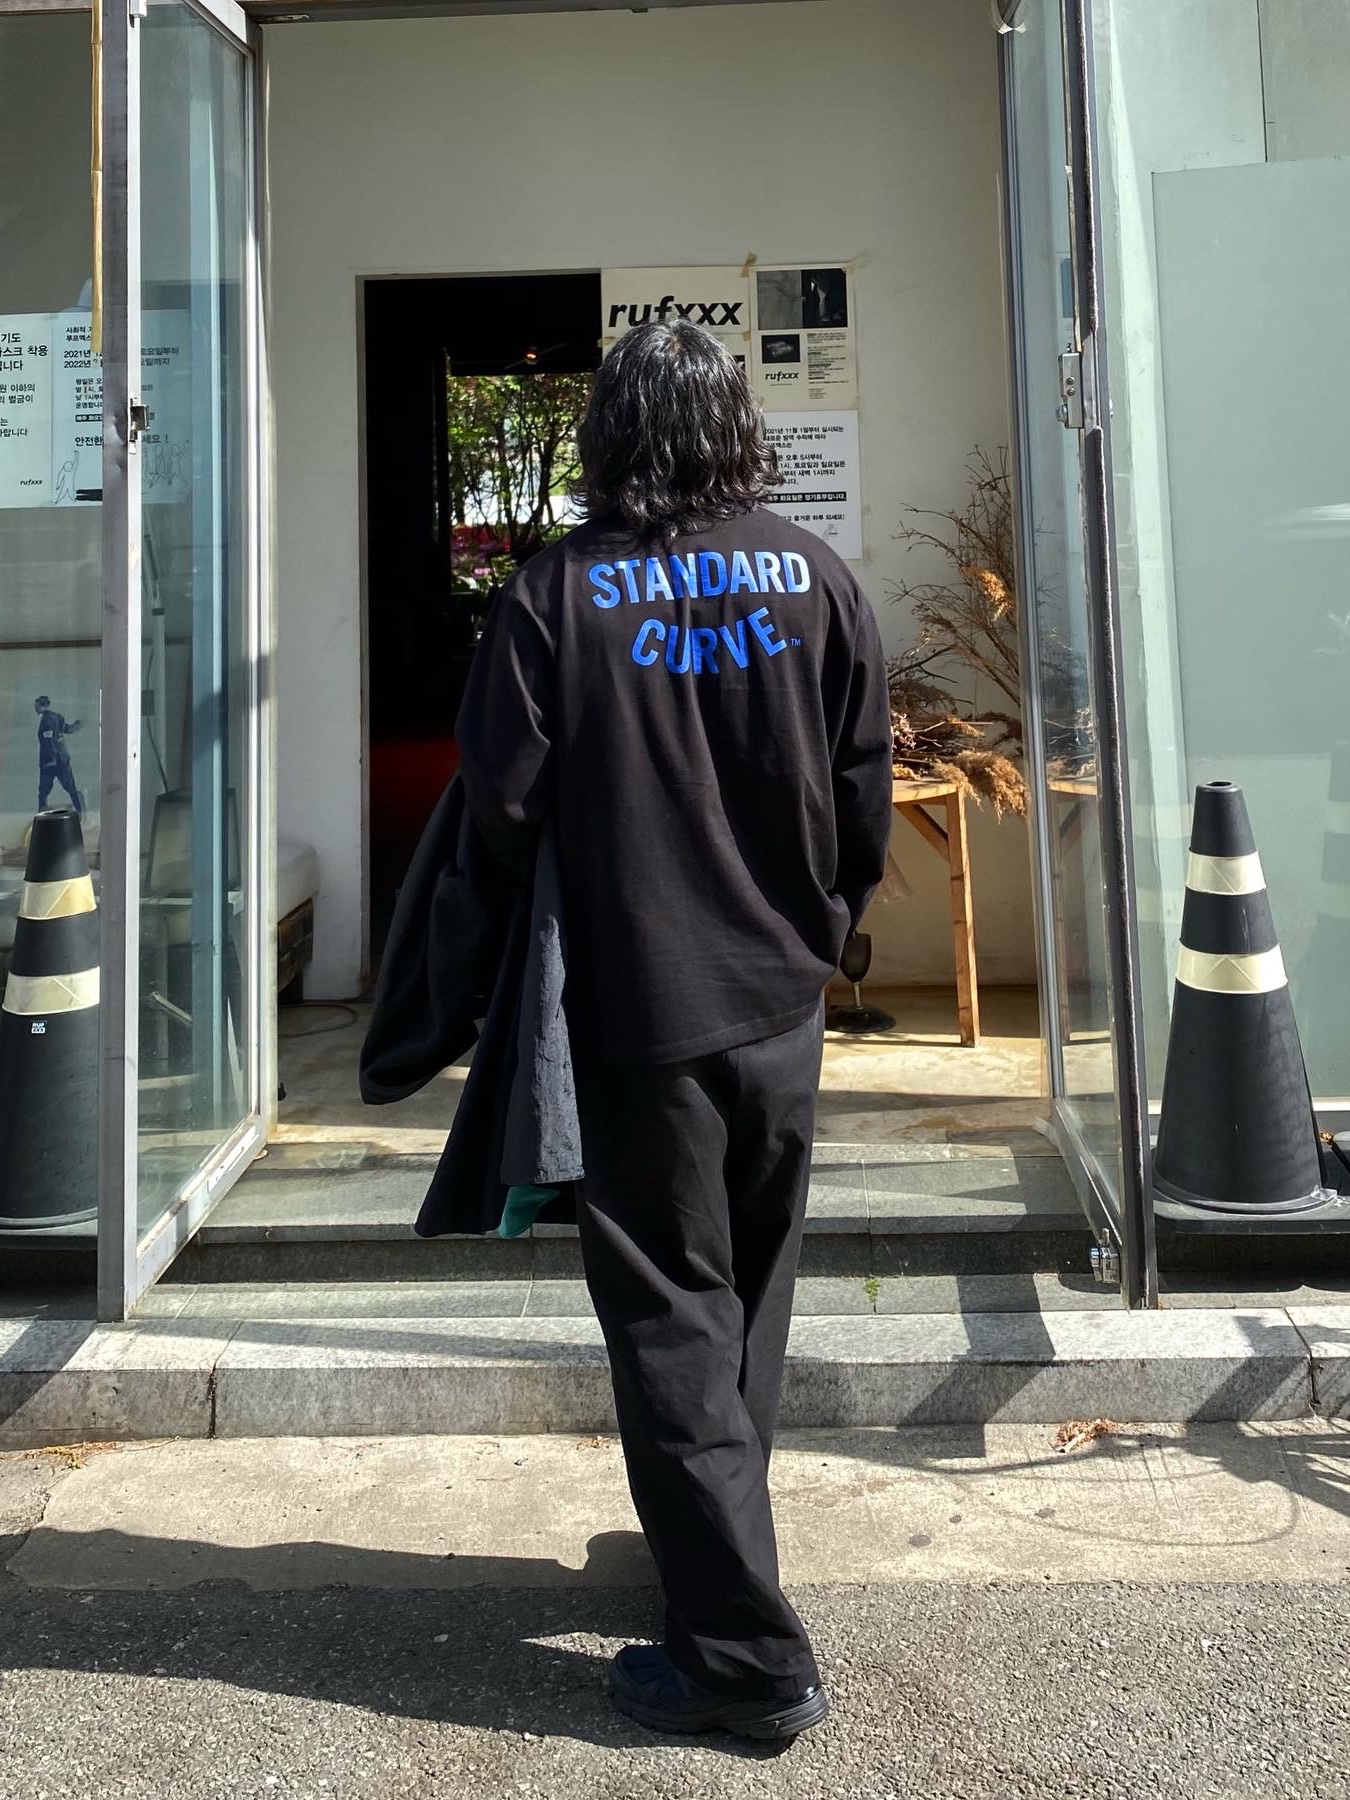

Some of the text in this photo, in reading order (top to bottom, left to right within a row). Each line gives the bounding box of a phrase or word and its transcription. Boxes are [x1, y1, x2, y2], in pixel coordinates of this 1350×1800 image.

[608, 295, 743, 328] rufxxx
[1, 332, 22, 343] 기도
[0, 345, 48, 357] 스크 착용
[64, 350, 91, 358] 2021년
[64, 360, 91, 368] 2022년
[765, 371, 800, 381] rufxxx
[10, 384, 36, 393] 이하의
[8, 395, 34, 404] 벌금이
[821, 460, 846, 468] 일요일은
[20, 478, 43, 486] rufxxx
[780, 494, 803, 502] 화요일은
[588, 550, 811, 609] STANDARD
[631, 606, 788, 675] CURVE
